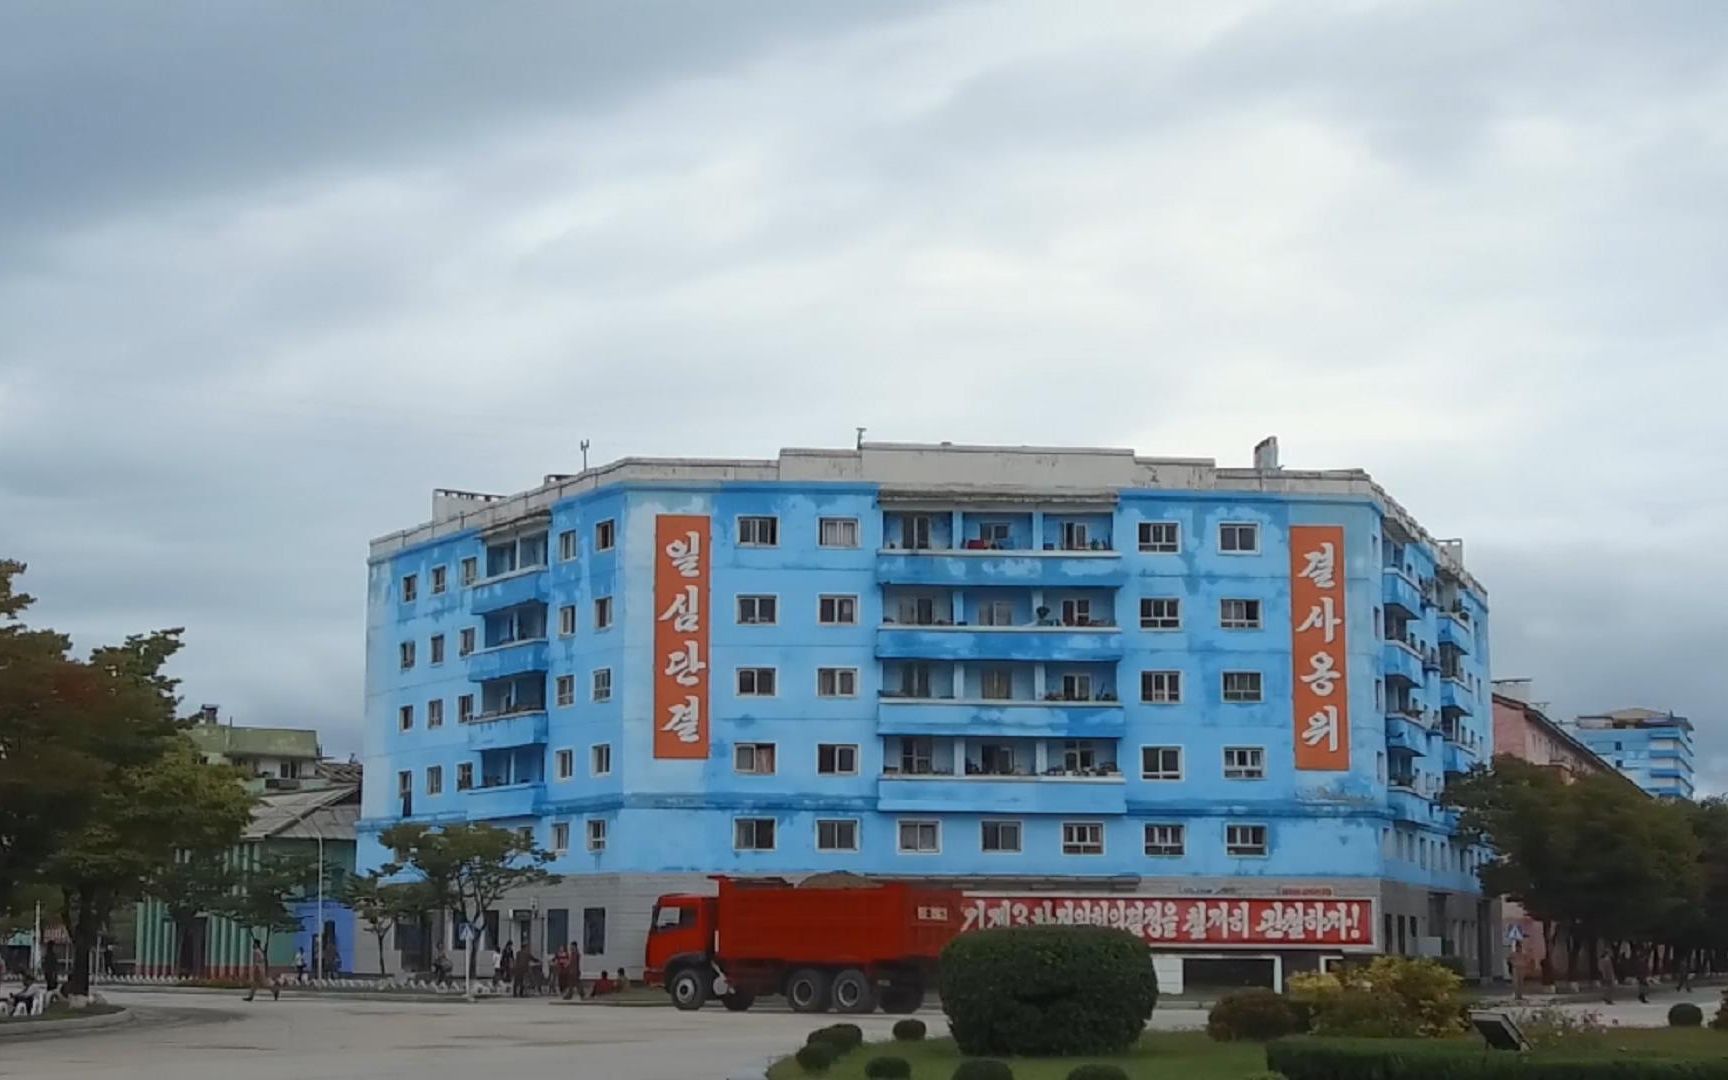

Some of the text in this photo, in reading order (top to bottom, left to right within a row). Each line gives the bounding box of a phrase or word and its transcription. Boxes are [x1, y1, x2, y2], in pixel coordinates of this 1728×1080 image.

[658, 530, 706, 743] 일심단결
[1295, 542, 1342, 752] 결사옹위
[1182, 901, 1249, 940] 철저히
[1255, 901, 1361, 941] 관철하자!
